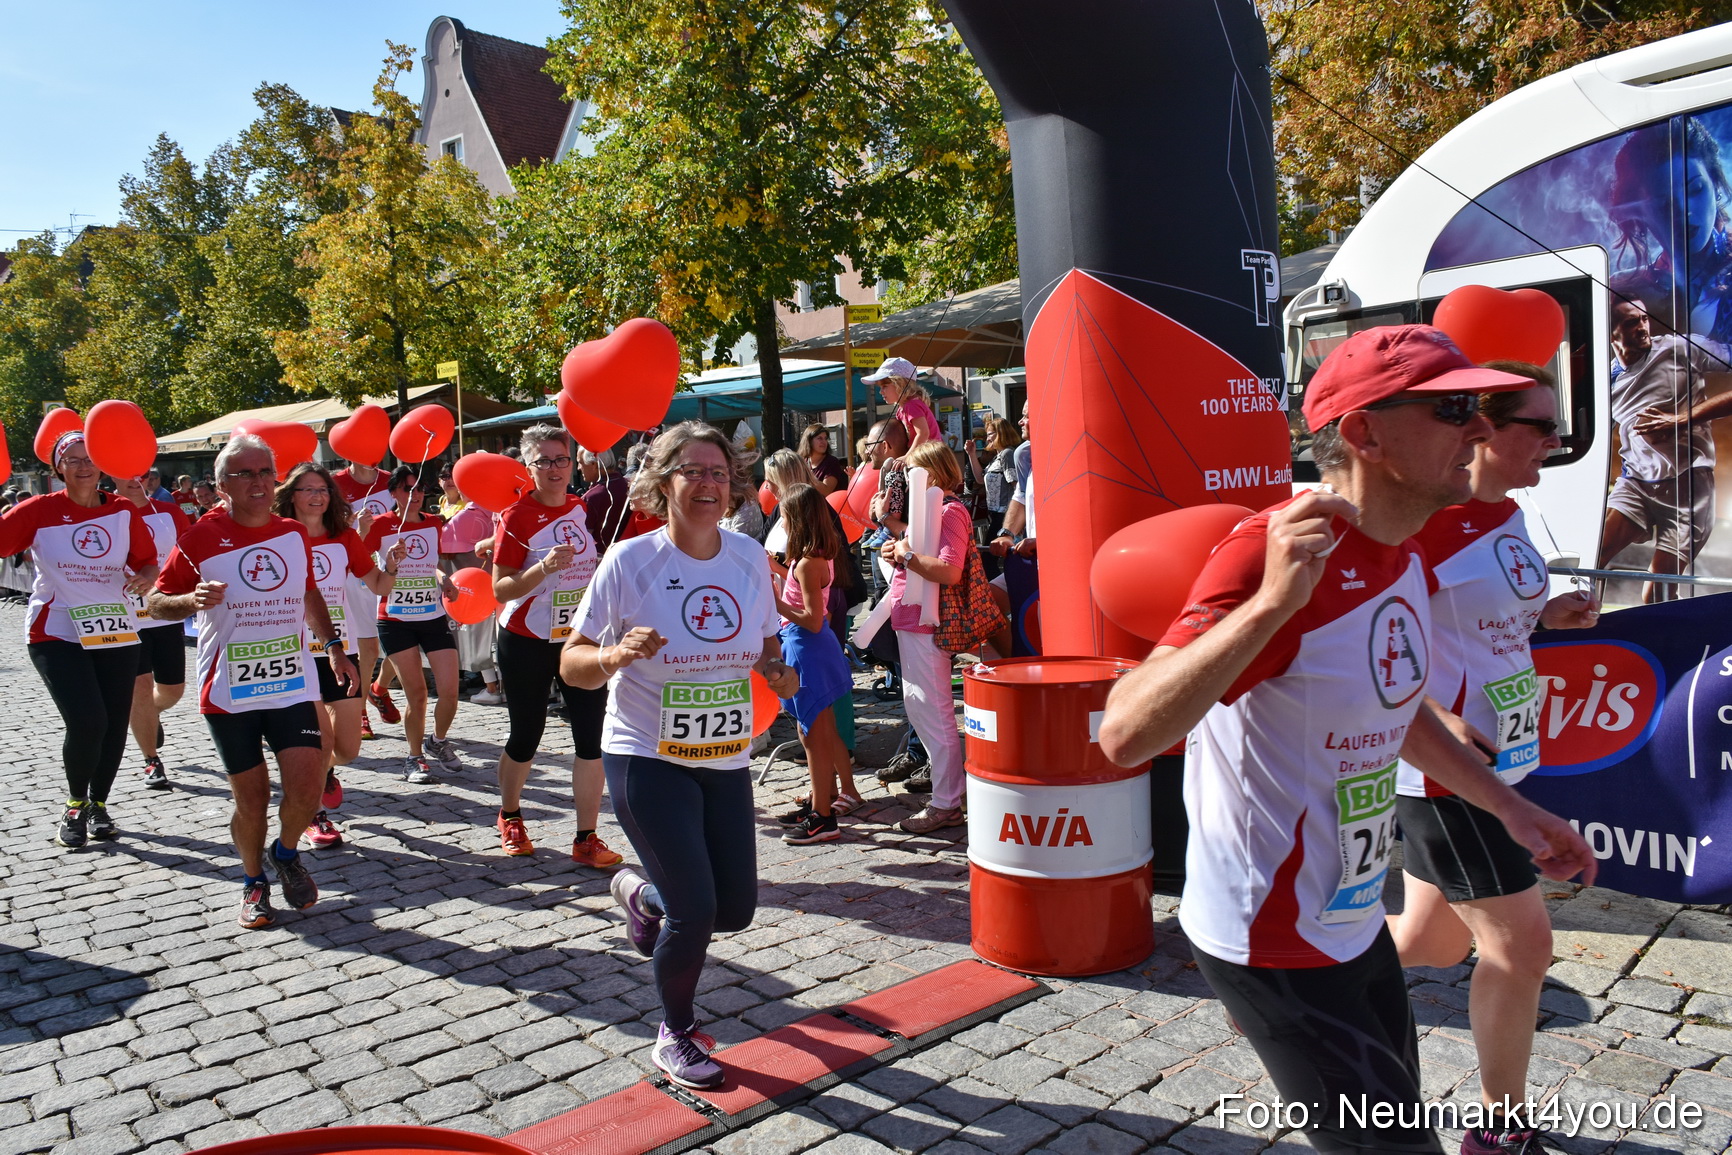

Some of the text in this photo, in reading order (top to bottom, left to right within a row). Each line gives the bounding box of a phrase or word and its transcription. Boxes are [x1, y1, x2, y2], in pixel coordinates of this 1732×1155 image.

[1245, 256, 1260, 264] Team
[1227, 377, 1280, 396] THE NEXT
[1200, 395, 1273, 416] 100 YEARS
[1205, 466, 1260, 491] BMW
[57, 562, 87, 570] LAUFEN
[226, 601, 261, 610] LAUFEN
[394, 591, 432, 604] 2454
[74, 605, 122, 618] BOCK
[81, 617, 129, 634] 5124
[233, 638, 295, 659] BOCK
[663, 653, 710, 664] LAUFEN
[716, 653, 737, 661] MIT
[237, 656, 297, 682] 2455
[250, 682, 288, 695] JOSEF
[671, 684, 743, 703] BOCK
[671, 709, 743, 739] 5123
[1324, 725, 1406, 751] LAUFEN MIT
[667, 742, 742, 758] CHRISTINA
[1339, 760, 1357, 773] Dr.
